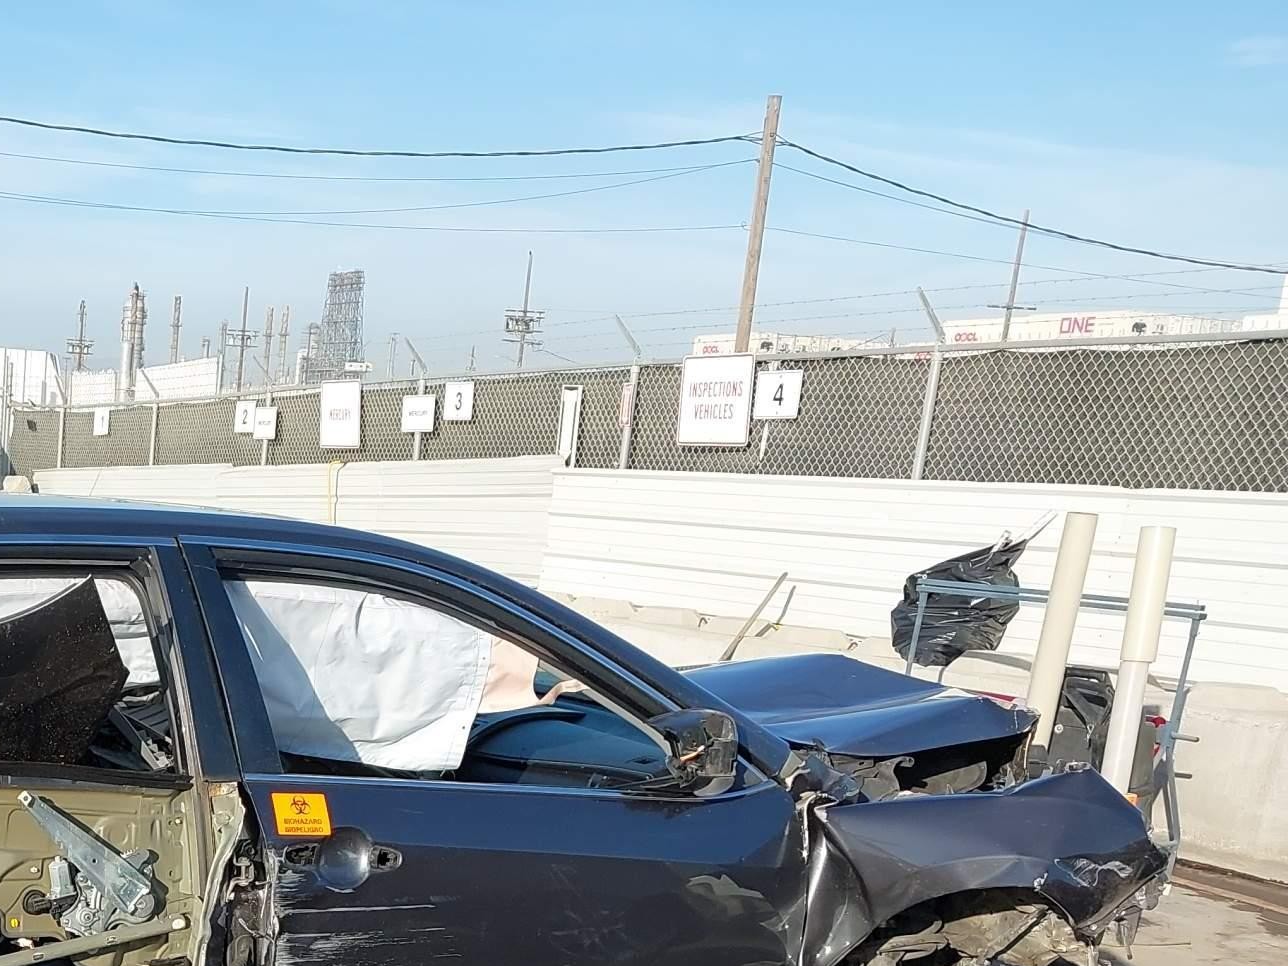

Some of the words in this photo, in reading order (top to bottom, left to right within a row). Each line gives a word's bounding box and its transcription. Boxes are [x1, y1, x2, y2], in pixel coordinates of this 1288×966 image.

[1059, 316, 1096, 335] ONE
[689, 381, 744, 398] INSPECTIONS
[773, 383, 784, 406] 4
[455, 392, 463, 410] 3
[241, 409, 248, 425] 2
[694, 404, 734, 420] VEHICLES
